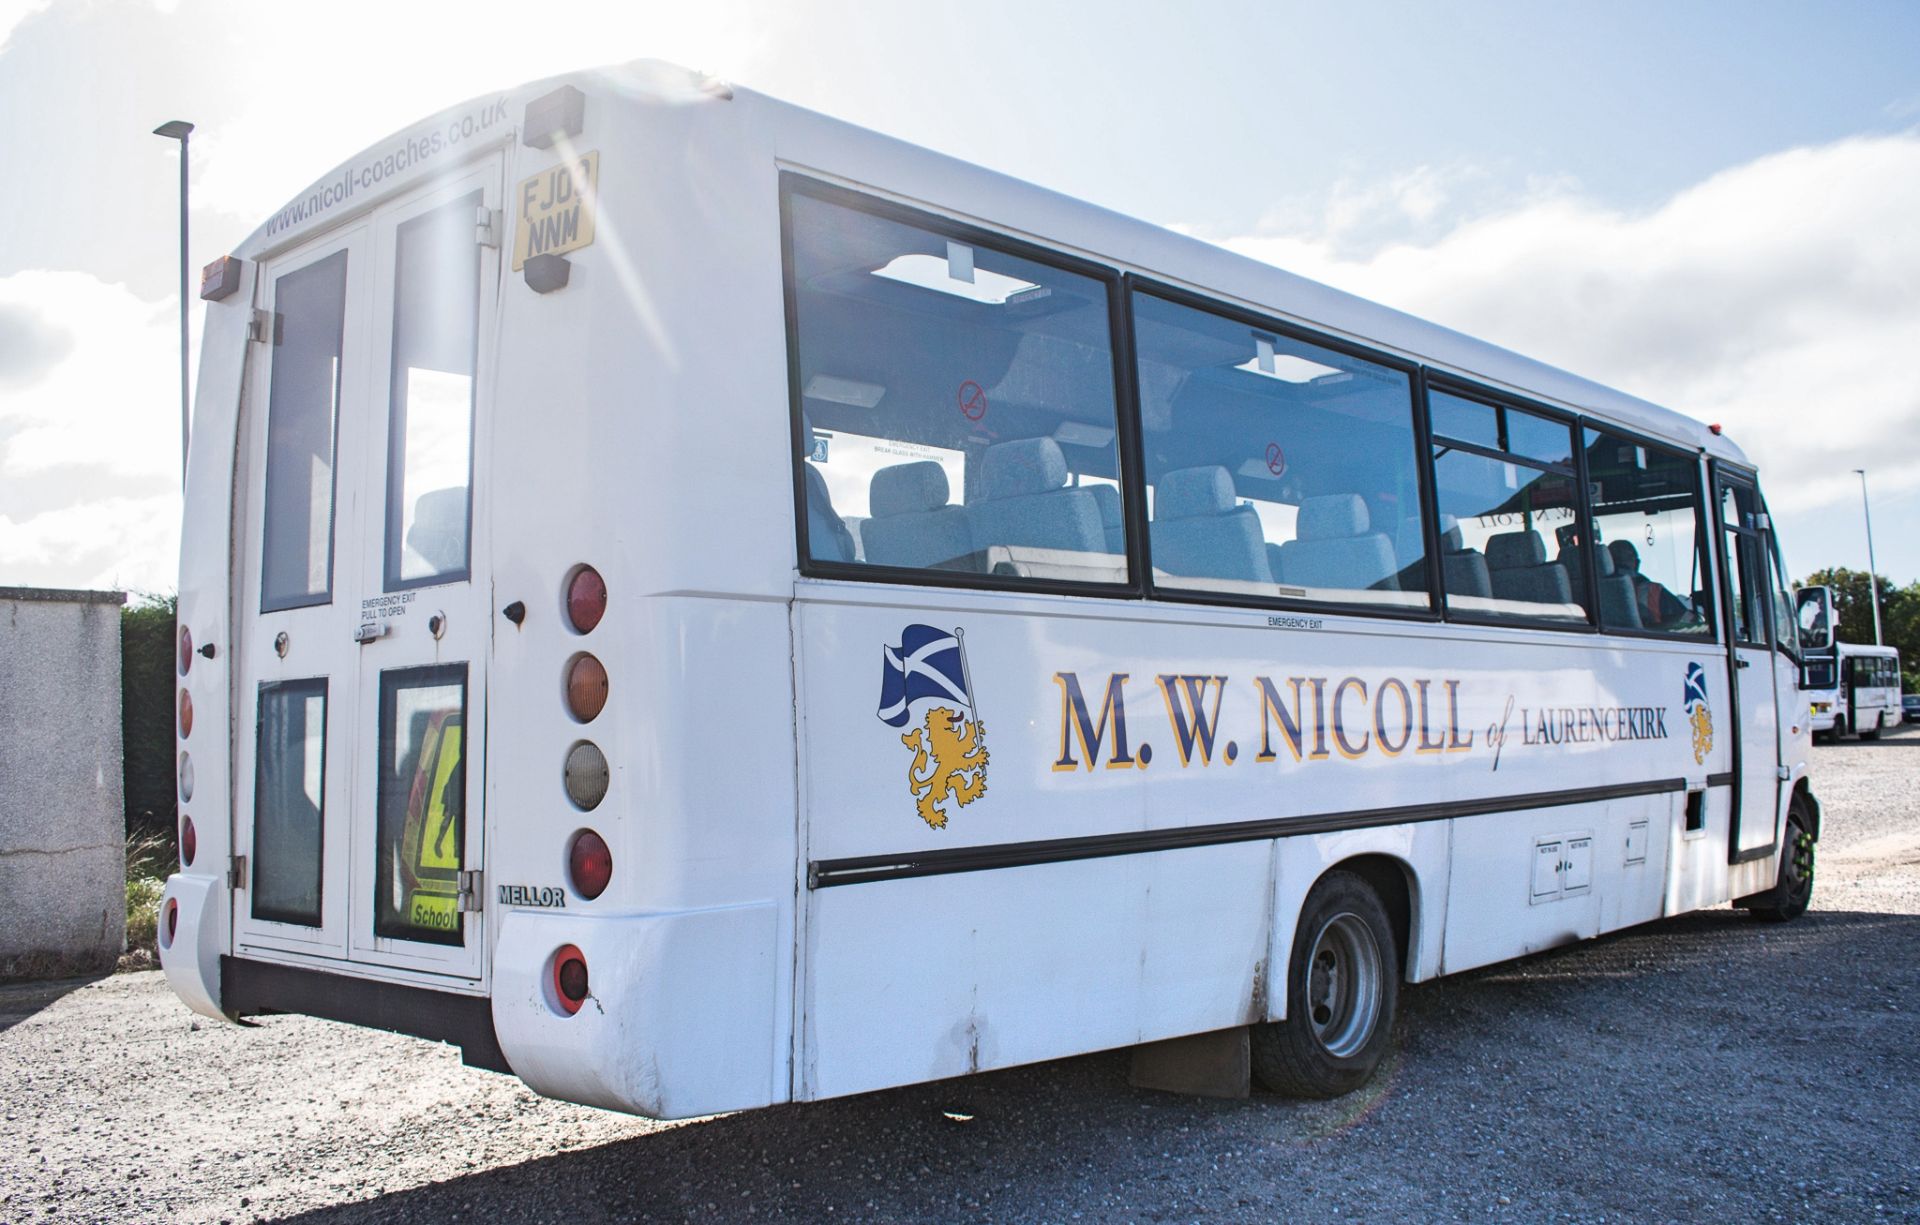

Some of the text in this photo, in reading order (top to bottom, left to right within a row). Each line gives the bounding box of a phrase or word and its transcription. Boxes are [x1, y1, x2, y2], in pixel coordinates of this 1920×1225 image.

[265, 96, 509, 237] www.nicoll-coaches.co.uk
[527, 205, 580, 257] NNM
[361, 605, 406, 620] PULL TO OPEN
[362, 592, 416, 609] EMERGENCY EXIT
[1268, 616, 1322, 629] EMERGENCY EXIT
[1052, 671, 1668, 773] M. W. NICOLL of LAURENCEKIRK
[498, 884, 566, 908] MELLOR
[414, 903, 455, 930] School
